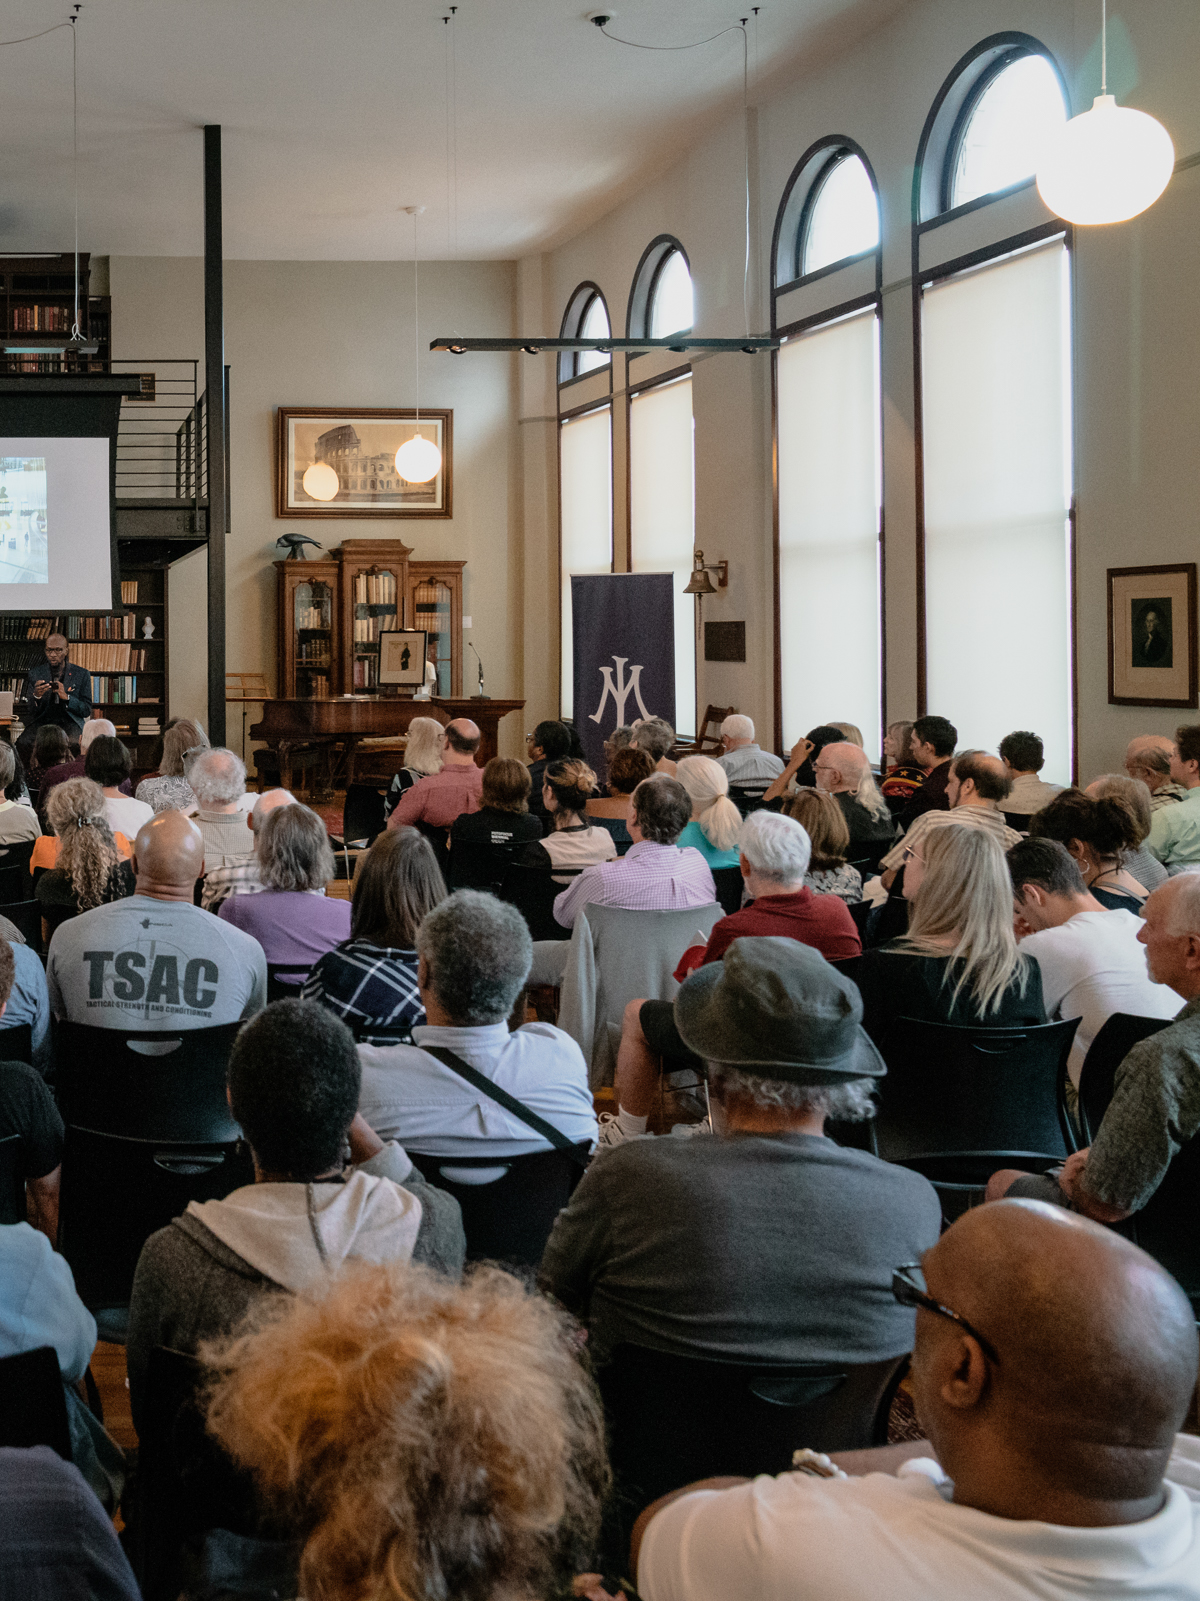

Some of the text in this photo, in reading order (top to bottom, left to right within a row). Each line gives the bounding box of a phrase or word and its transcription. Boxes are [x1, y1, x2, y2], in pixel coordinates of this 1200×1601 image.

[83, 950, 218, 1009] TSAC
[86, 1000, 114, 1008] TACTICAL
[151, 1004, 164, 1013] AND
[165, 1006, 213, 1019] CONDITIONING
